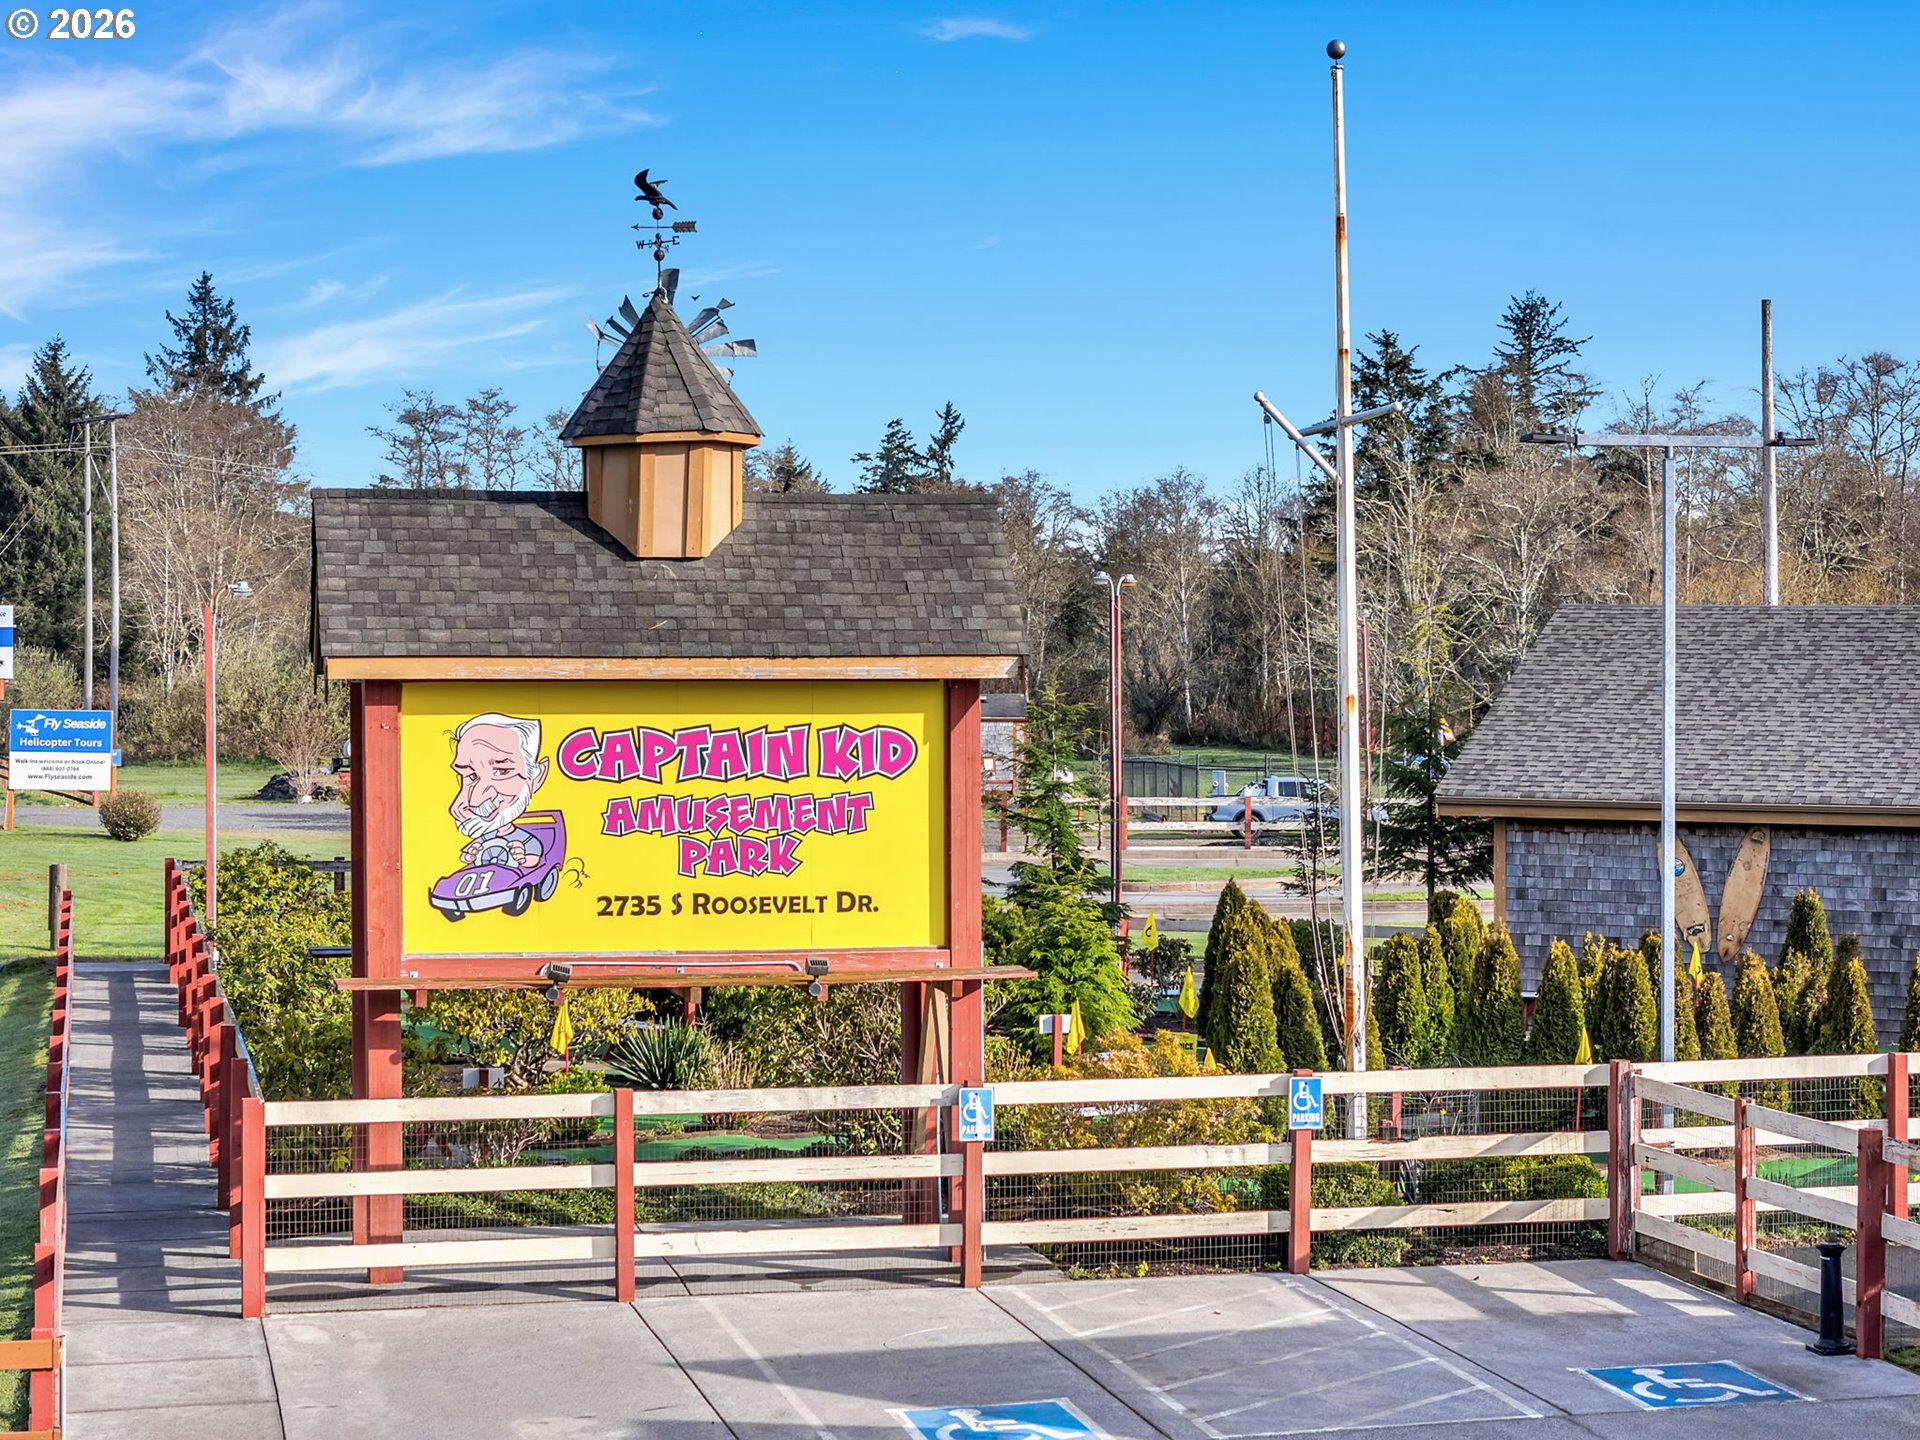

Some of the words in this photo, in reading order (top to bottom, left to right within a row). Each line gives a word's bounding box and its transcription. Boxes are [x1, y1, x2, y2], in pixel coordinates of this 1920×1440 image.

[44, 719, 61, 730] Fly
[63, 719, 106, 728] Seaside
[19, 737, 72, 748] Helicopter
[74, 738, 103, 748] Tours
[557, 723, 812, 783] CAPTAIN
[816, 723, 918, 783] KID
[27, 773, 93, 781] www.Flyseaside.com
[601, 791, 874, 837] AMUSEMENT
[678, 833, 803, 878] PARK
[455, 870, 496, 897] 01
[596, 895, 662, 916] 2735
[671, 892, 683, 915] S
[1292, 1113, 1320, 1123] PARKING
